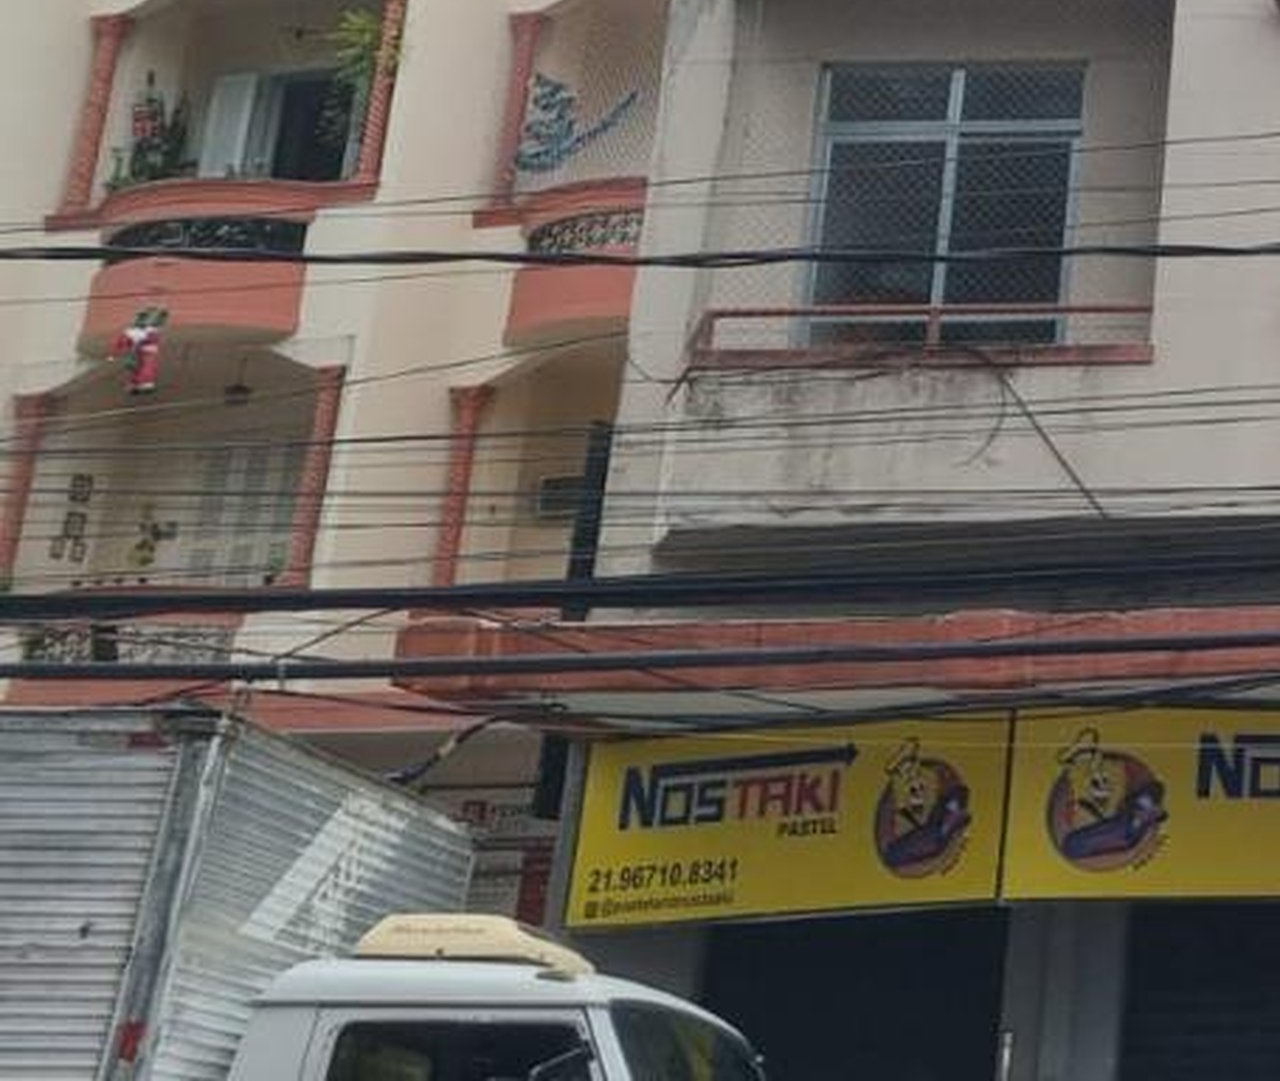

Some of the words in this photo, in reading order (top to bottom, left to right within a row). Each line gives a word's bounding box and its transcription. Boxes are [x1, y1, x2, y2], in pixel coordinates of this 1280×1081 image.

[618, 765, 843, 831] NOSTAKI
[779, 818, 839, 838] PASTEL
[588, 858, 740, 894] 21.96710.8341
